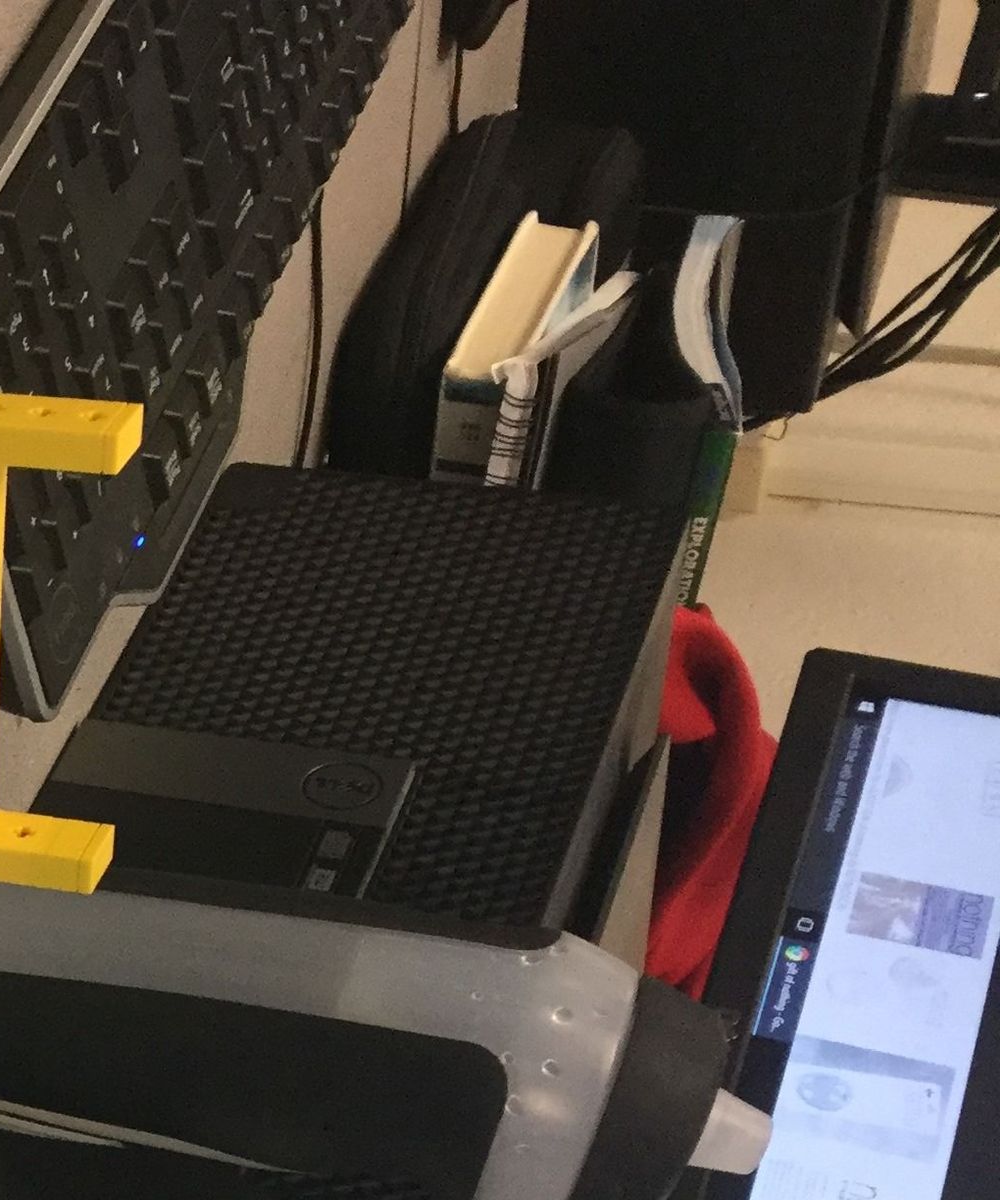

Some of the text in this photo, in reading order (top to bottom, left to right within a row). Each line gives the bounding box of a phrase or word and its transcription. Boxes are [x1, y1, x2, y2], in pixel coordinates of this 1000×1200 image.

[784, 961, 800, 975] gift
[784, 975, 799, 985] of
[773, 986, 796, 1012] nothing
